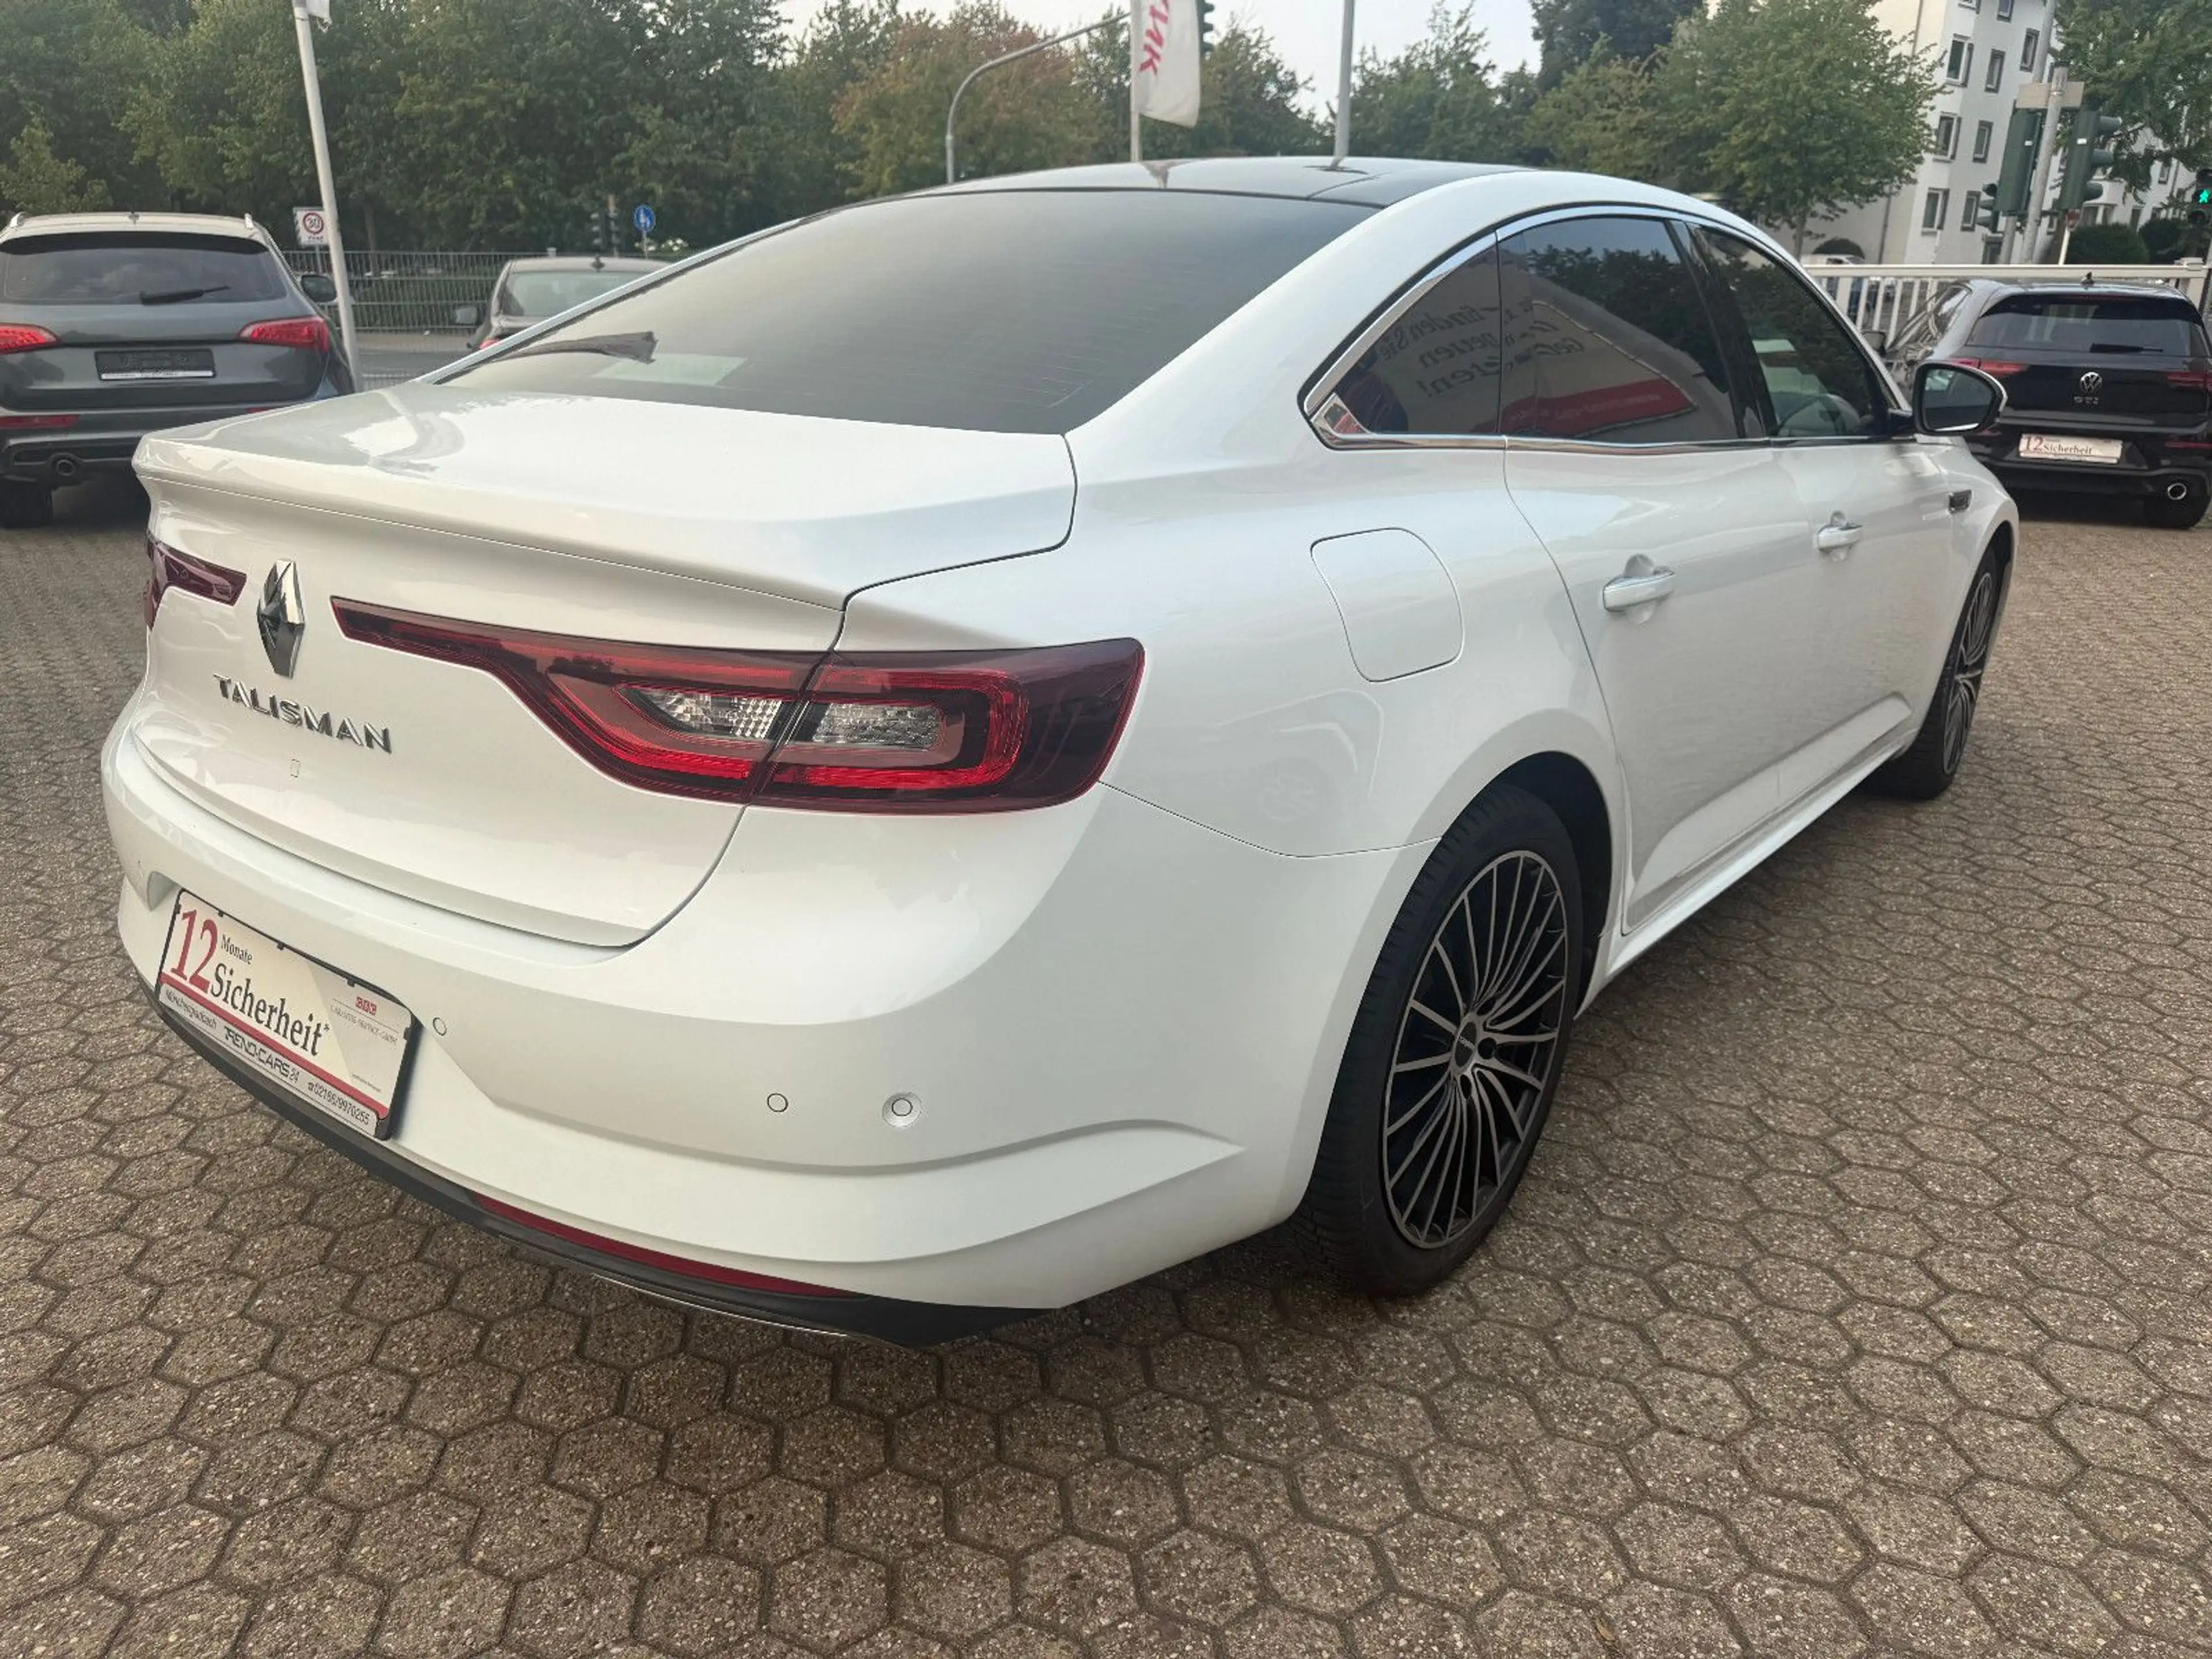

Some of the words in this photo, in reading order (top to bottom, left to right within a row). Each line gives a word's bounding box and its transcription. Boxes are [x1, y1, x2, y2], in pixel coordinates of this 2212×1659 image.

[2025, 435, 2044, 451] 12
[2043, 443, 2092, 454] Sicherheit
[213, 673, 392, 754] TALISMAN
[171, 909, 218, 995] 12
[221, 933, 253, 965] Monate
